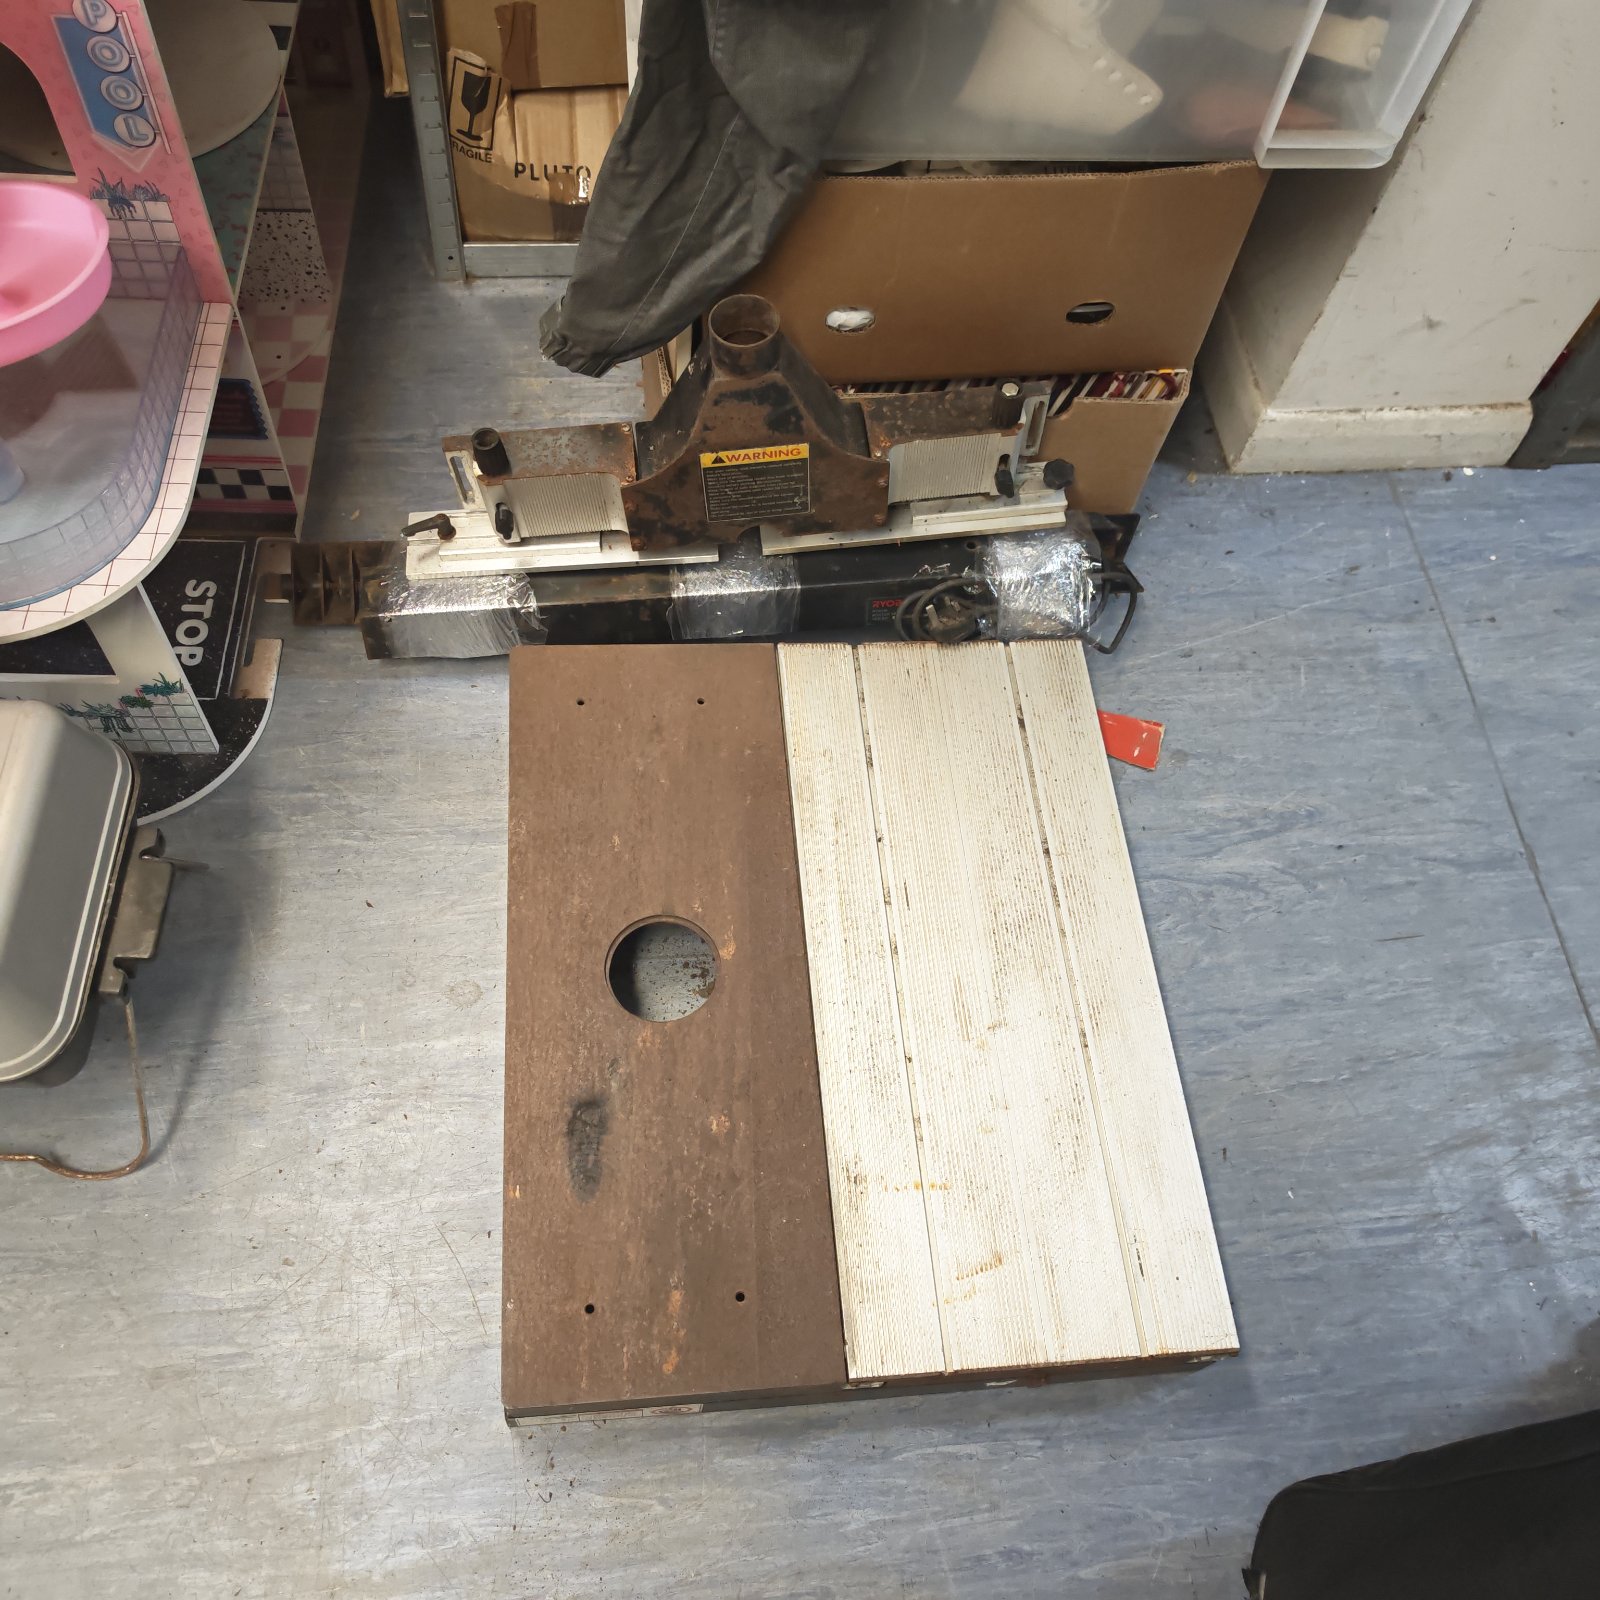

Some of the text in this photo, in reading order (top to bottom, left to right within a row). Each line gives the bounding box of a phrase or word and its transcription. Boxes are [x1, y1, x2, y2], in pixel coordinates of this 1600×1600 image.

[80, 0, 150, 142] POOL
[450, 140, 493, 164] RAGILE
[725, 447, 802, 463] WARNING
[173, 579, 218, 667] STOP
